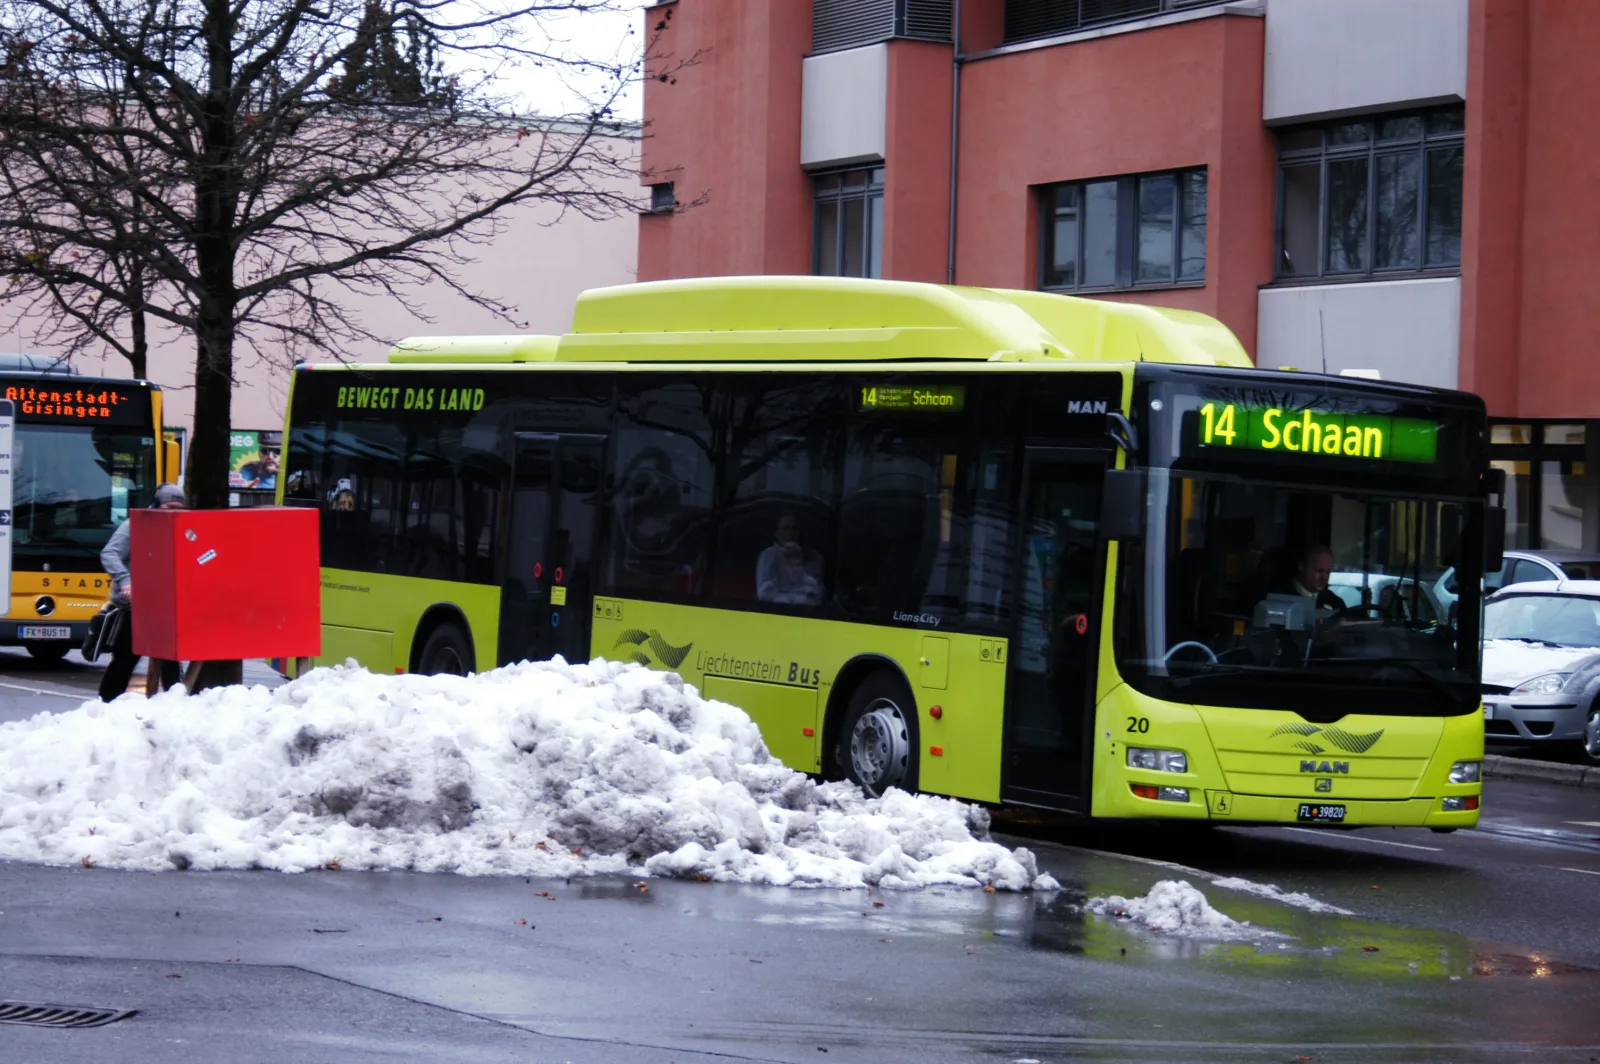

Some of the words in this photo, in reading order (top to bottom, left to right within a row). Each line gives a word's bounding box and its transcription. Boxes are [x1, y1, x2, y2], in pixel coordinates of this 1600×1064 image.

[6, 386, 128, 405] Altenstadt-
[336, 387, 400, 409] BEWEGT
[403, 387, 435, 410] DAS
[439, 388, 485, 411] LAND
[861, 387, 877, 406] 14
[912, 390, 953, 406] Schaan
[22, 400, 111, 418] Gisingen
[1067, 400, 1107, 414] MAN
[1200, 402, 1237, 446] 14
[1261, 408, 1382, 458] Schaan
[26, 628, 36, 637] FK
[42, 628, 57, 637] BUS
[59, 628, 67, 637] 11
[696, 650, 781, 681] Liechtenstein
[787, 661, 821, 686] Bus
[1127, 716, 1150, 734] 20
[1300, 760, 1349, 774] MAN
[1300, 806, 1311, 817] FL
[1318, 806, 1344, 818] 39820
